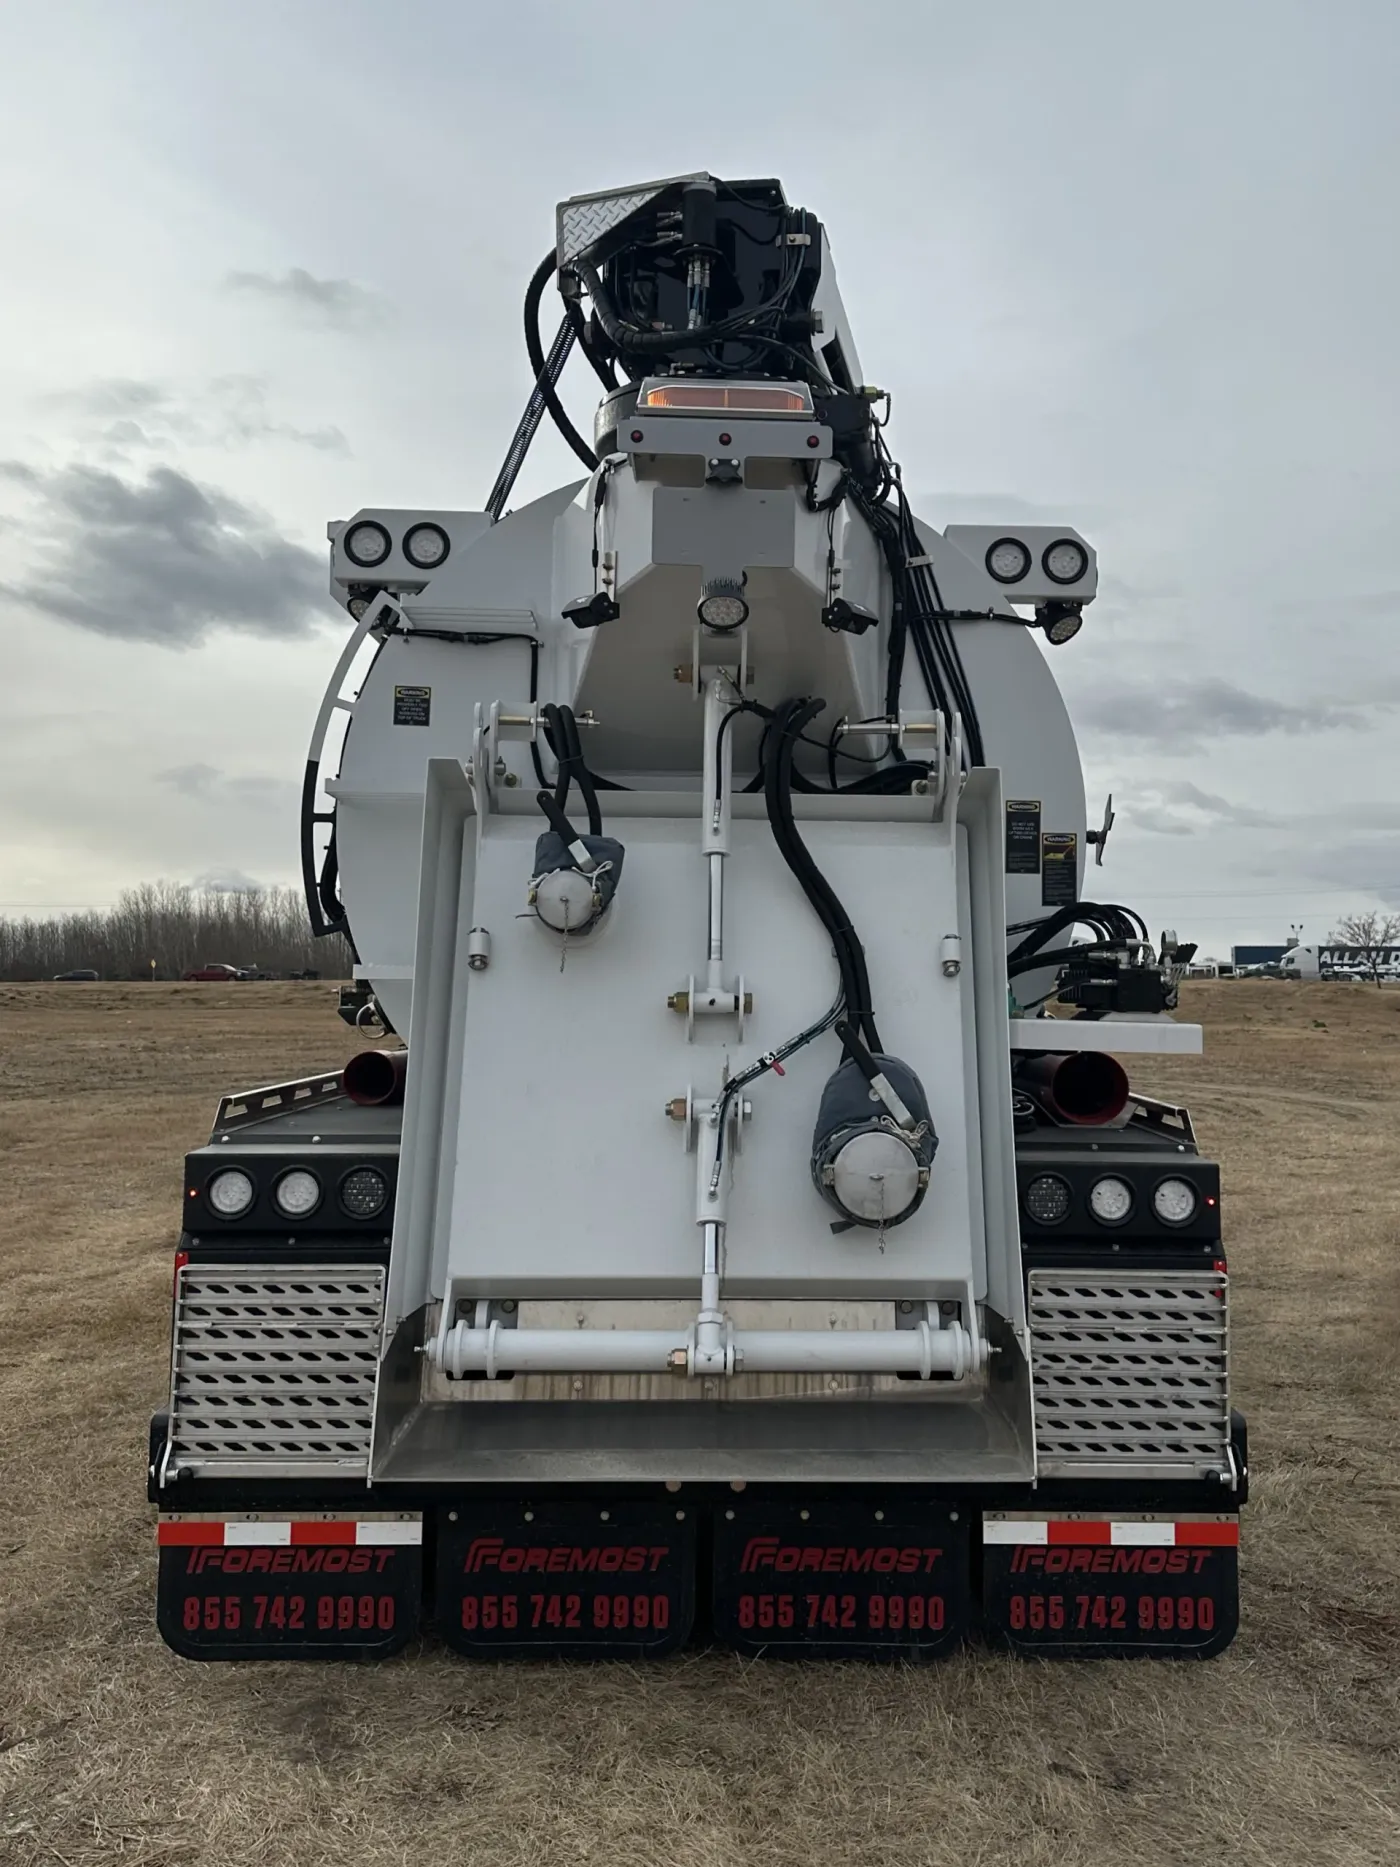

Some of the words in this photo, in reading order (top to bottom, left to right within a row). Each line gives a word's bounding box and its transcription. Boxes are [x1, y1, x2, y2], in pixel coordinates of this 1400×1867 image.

[186, 1546, 396, 1574] FOREMOST
[464, 1538, 669, 1573] FOREMOST
[740, 1537, 943, 1573] FOREMOST
[1010, 1545, 1213, 1574] FOREMOST
[183, 1597, 241, 1630] 855
[253, 1596, 305, 1630] 742
[317, 1596, 395, 1630] 9990
[461, 1596, 518, 1629] 855
[530, 1595, 581, 1628] 742
[593, 1595, 669, 1629] 9990
[738, 1595, 794, 1629] 855
[806, 1595, 856, 1628] 742
[868, 1595, 944, 1630] 9990
[1009, 1595, 1065, 1630] 855
[1075, 1595, 1126, 1629] 742
[1138, 1596, 1214, 1630] 9990
